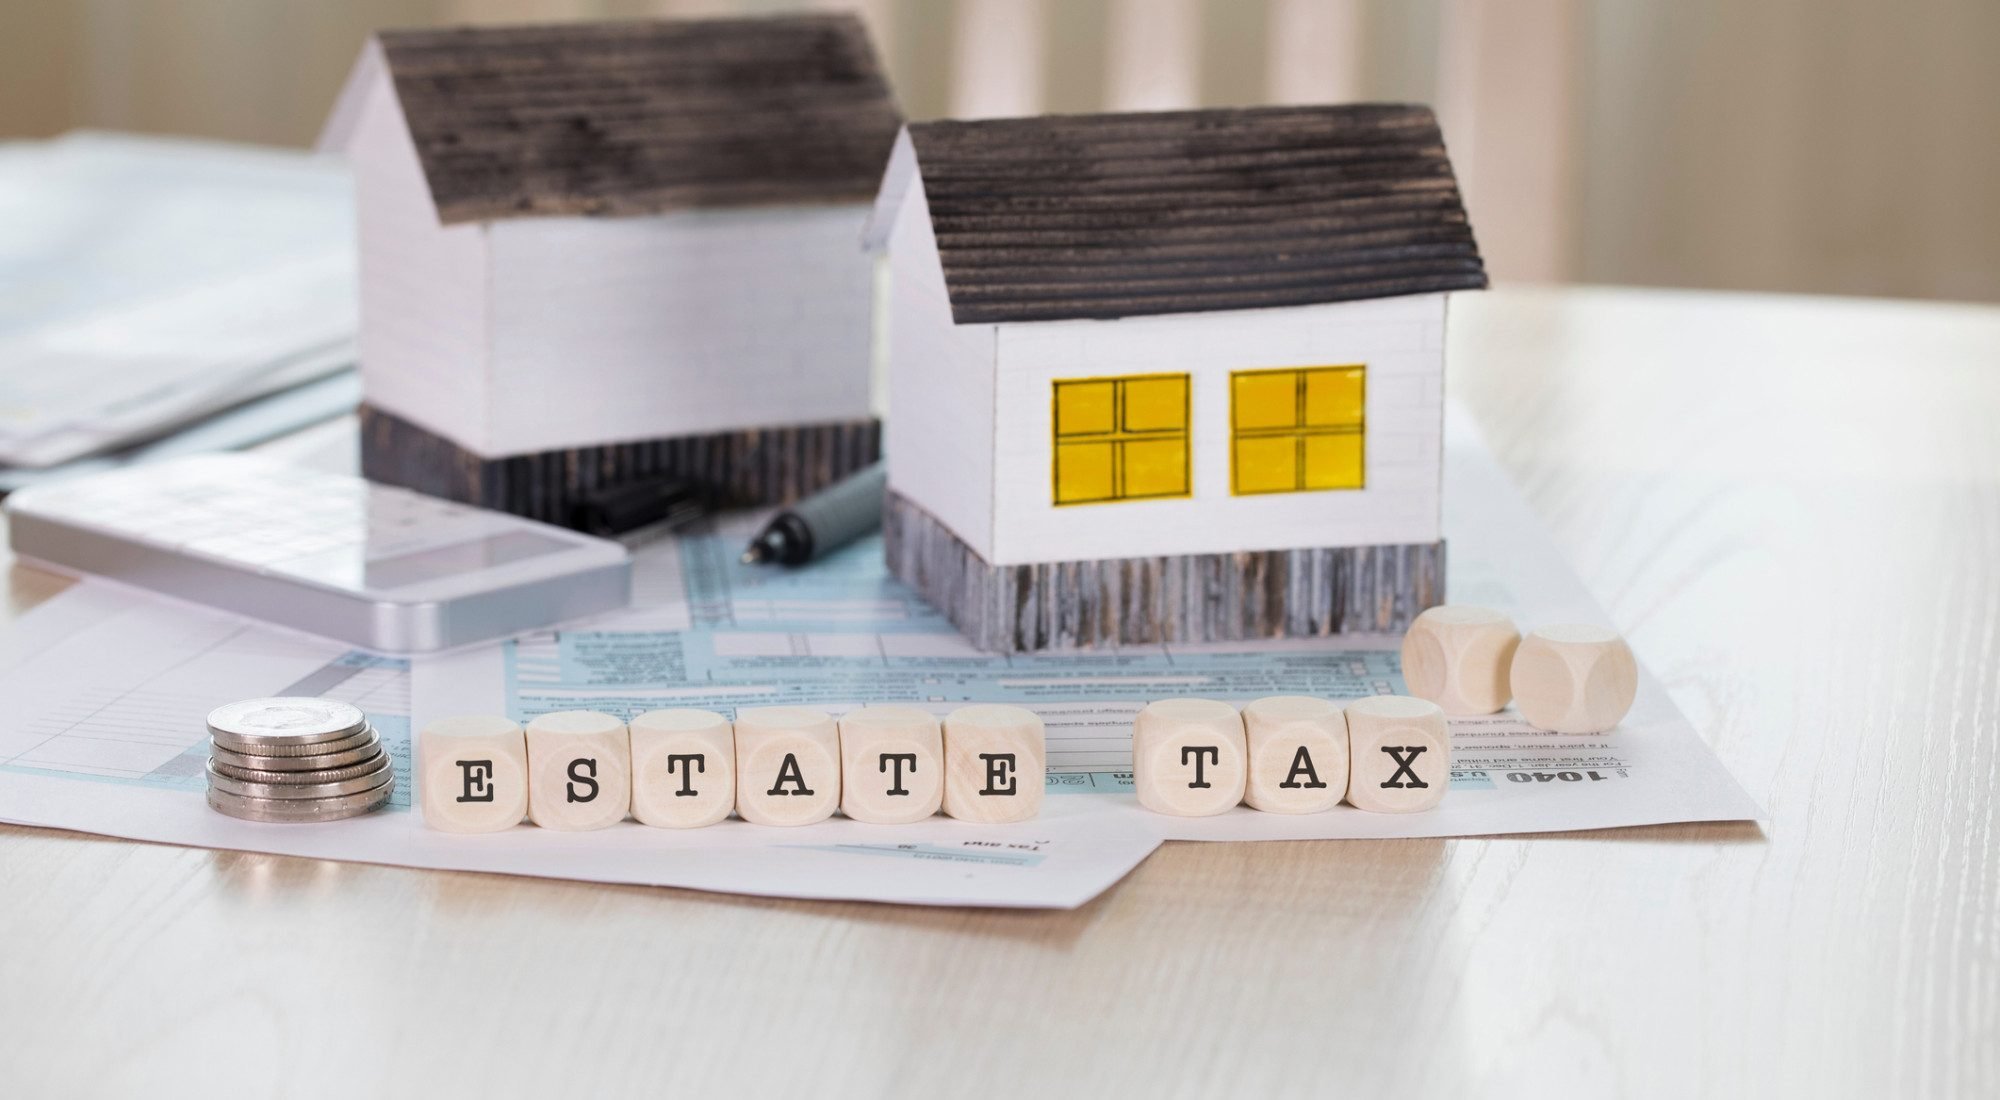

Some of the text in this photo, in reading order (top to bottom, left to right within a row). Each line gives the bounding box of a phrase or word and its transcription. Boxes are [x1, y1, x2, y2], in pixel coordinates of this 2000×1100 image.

[456, 754, 1016, 802] ESTATE
[1182, 746, 1428, 788] TAX
[1506, 771, 1609, 783] 1040
[1007, 843, 1040, 852] Tax
